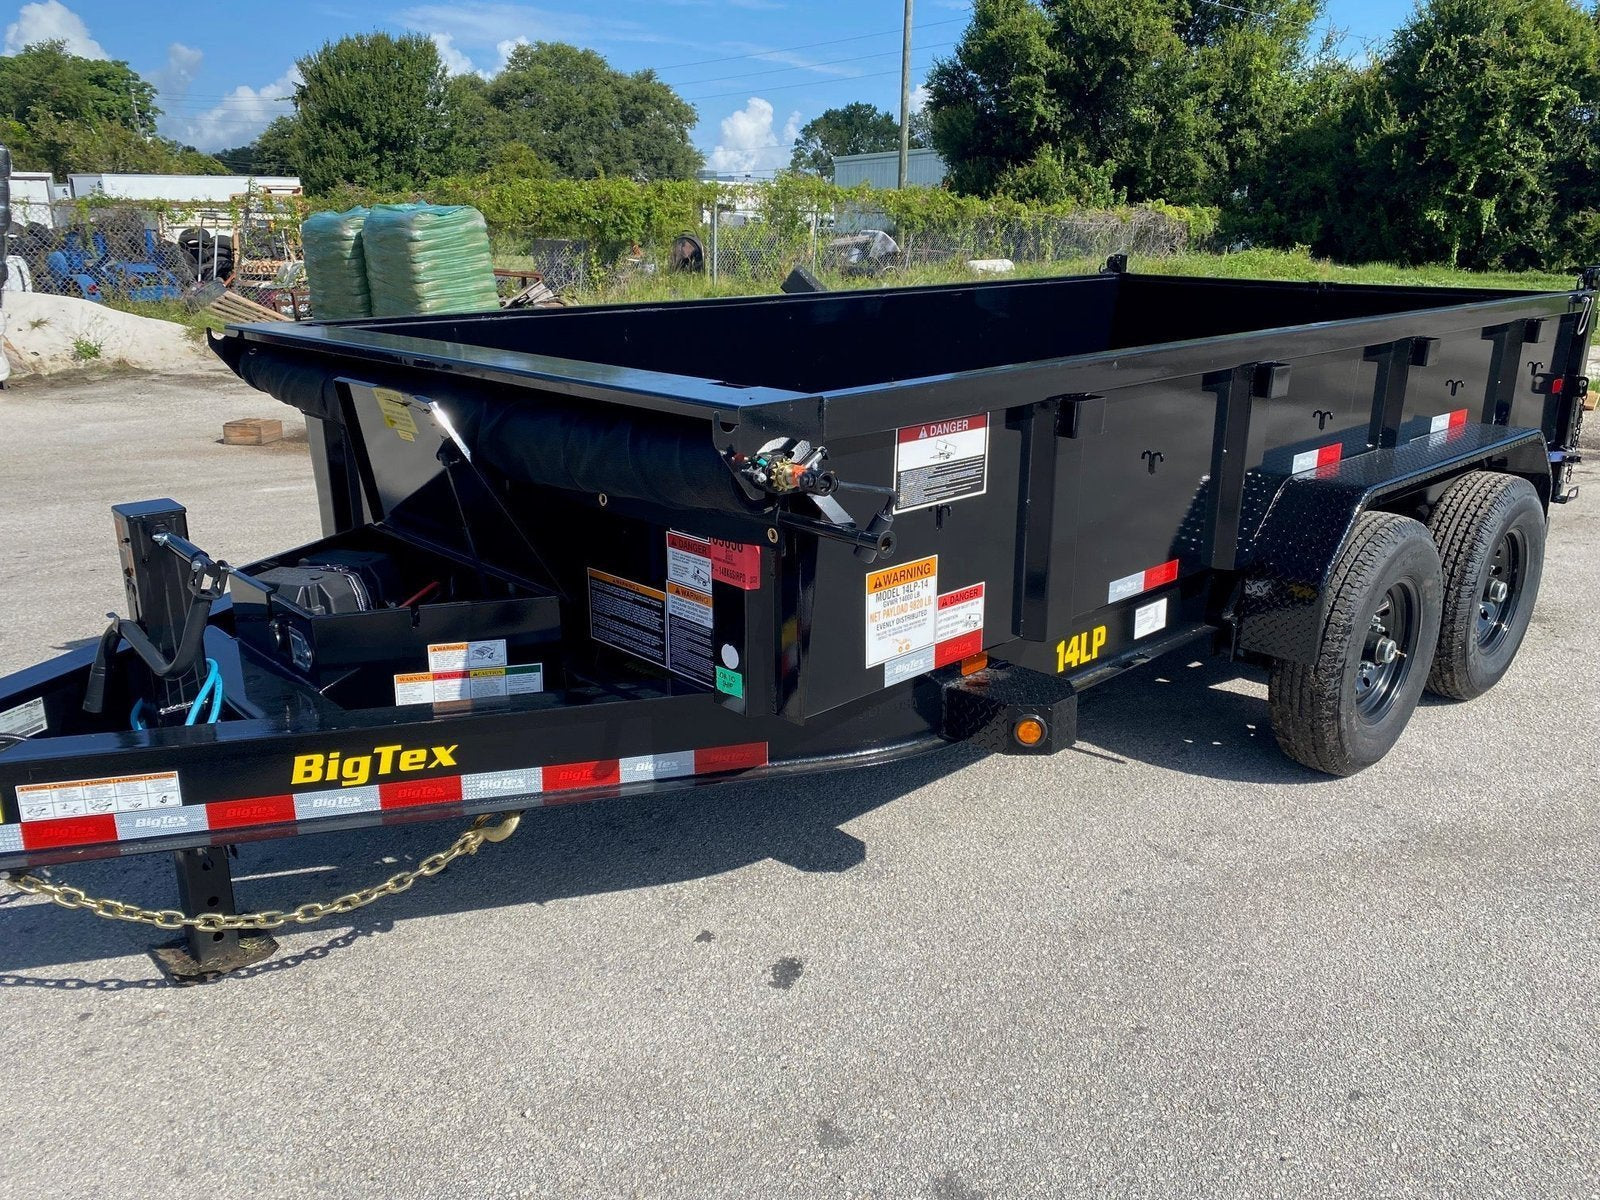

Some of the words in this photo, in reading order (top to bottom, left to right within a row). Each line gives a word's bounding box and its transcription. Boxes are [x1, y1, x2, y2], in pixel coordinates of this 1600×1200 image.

[930, 420, 969, 436] DANGER
[680, 541, 707, 555] DANGER
[883, 563, 931, 586] WARNING
[680, 589, 709, 603] WARNING
[876, 588, 900, 603] MODEL
[903, 579, 929, 595] 14LP-14
[950, 588, 978, 605] DANGER
[883, 603, 908, 619] PAYLOAD
[877, 620, 895, 631] EVENLY
[896, 610, 928, 625] DISTRIBUTED
[1056, 625, 1107, 673] 14LP
[290, 744, 459, 787] BigTex
[635, 760, 679, 772] BigTex
[478, 776, 526, 790] BigTex
[397, 786, 446, 799] BigTex
[313, 796, 362, 808] BigTex
[226, 805, 277, 818] BigTex
[135, 814, 188, 828] BigTex
